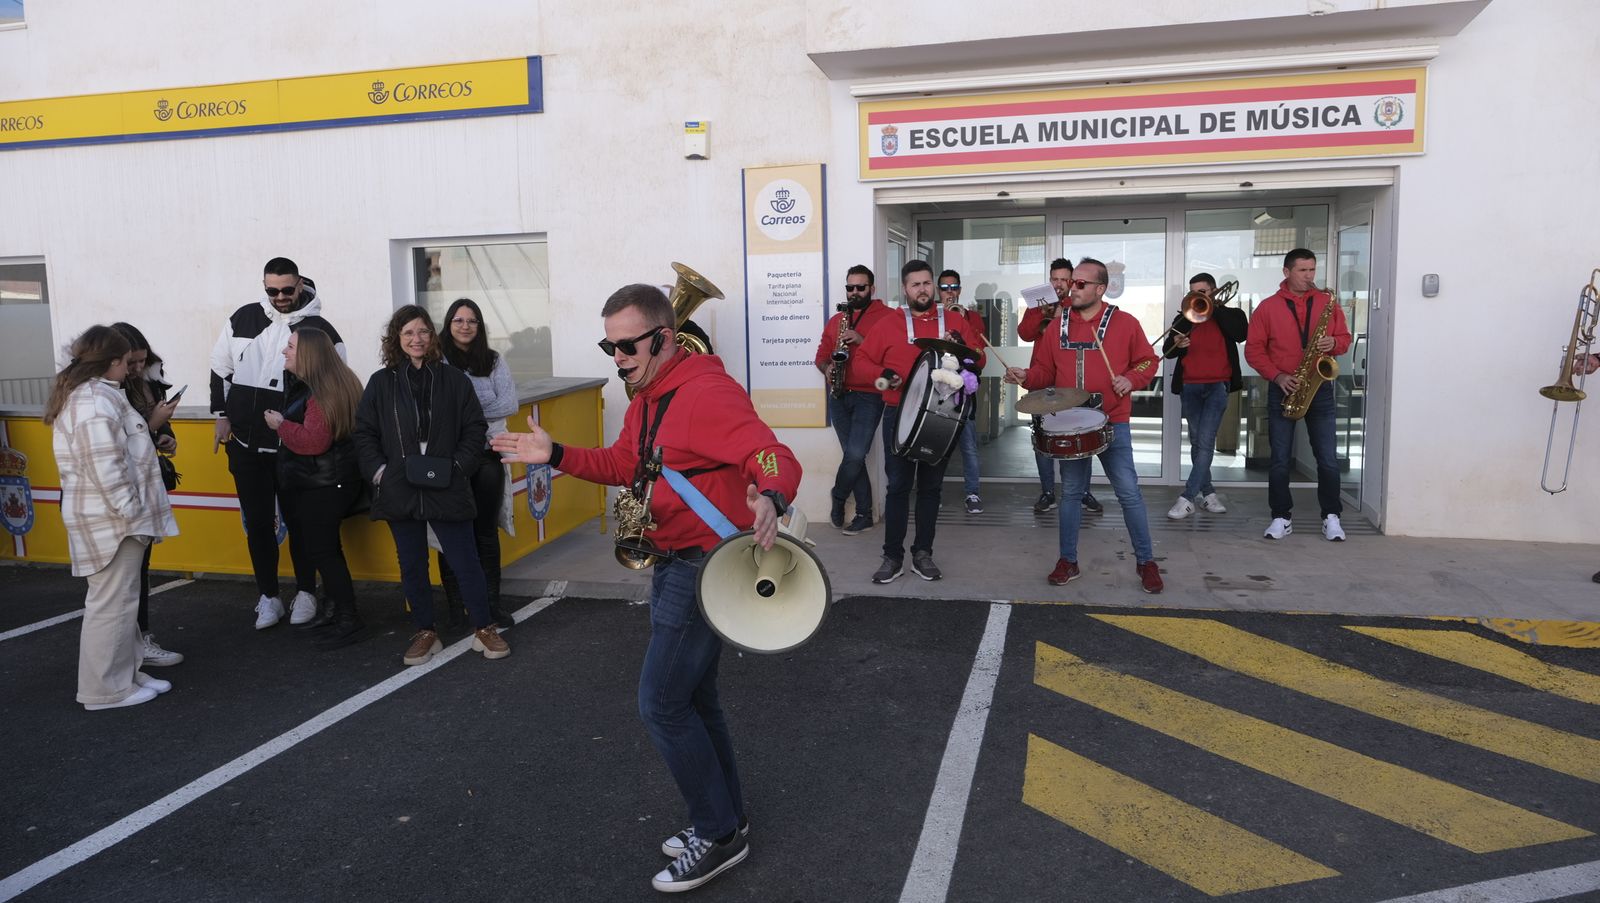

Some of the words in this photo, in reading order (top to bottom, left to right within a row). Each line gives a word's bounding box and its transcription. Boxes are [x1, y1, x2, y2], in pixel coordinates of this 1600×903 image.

[393, 80, 473, 103] CORREOS
[176, 99, 247, 120] CORREOS
[909, 123, 1029, 150] ESCUELA
[1037, 113, 1190, 143] MUNICIPAL
[1200, 111, 1236, 134] DE
[1246, 103, 1362, 131] MÚSICA
[761, 214, 806, 226] Correos
[789, 313, 810, 321] dinero
[785, 337, 812, 345] prepago
